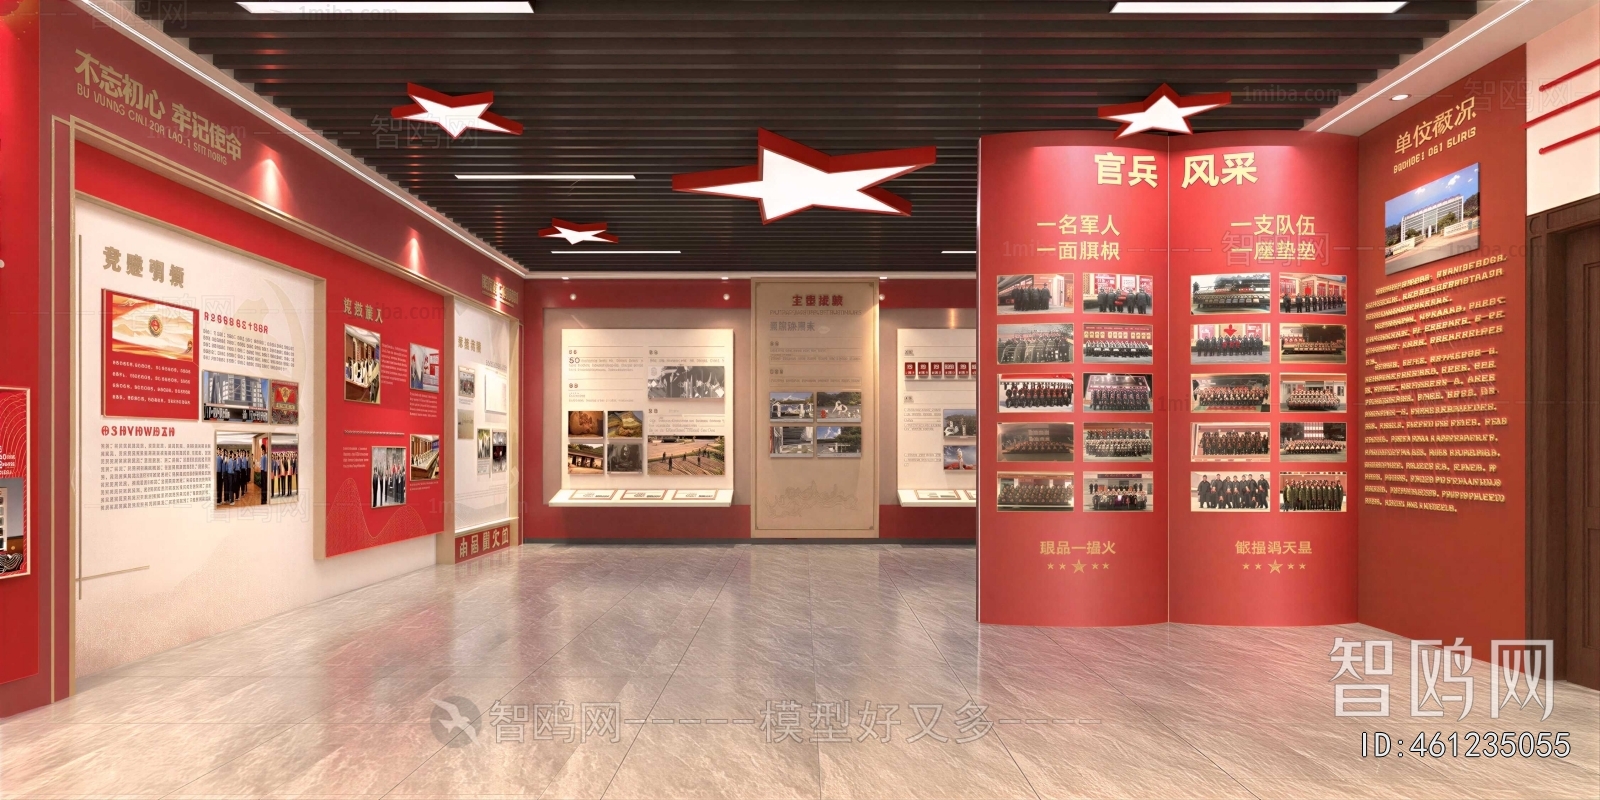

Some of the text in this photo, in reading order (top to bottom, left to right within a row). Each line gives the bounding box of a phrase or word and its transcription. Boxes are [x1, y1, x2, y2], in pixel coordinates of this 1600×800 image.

[74, 48, 242, 161] 不忘初心 牢记使命
[1094, 151, 1258, 189] 官兵 风采
[1036, 214, 1121, 236] 一名军人
[1230, 214, 1316, 236] 一支队伍
